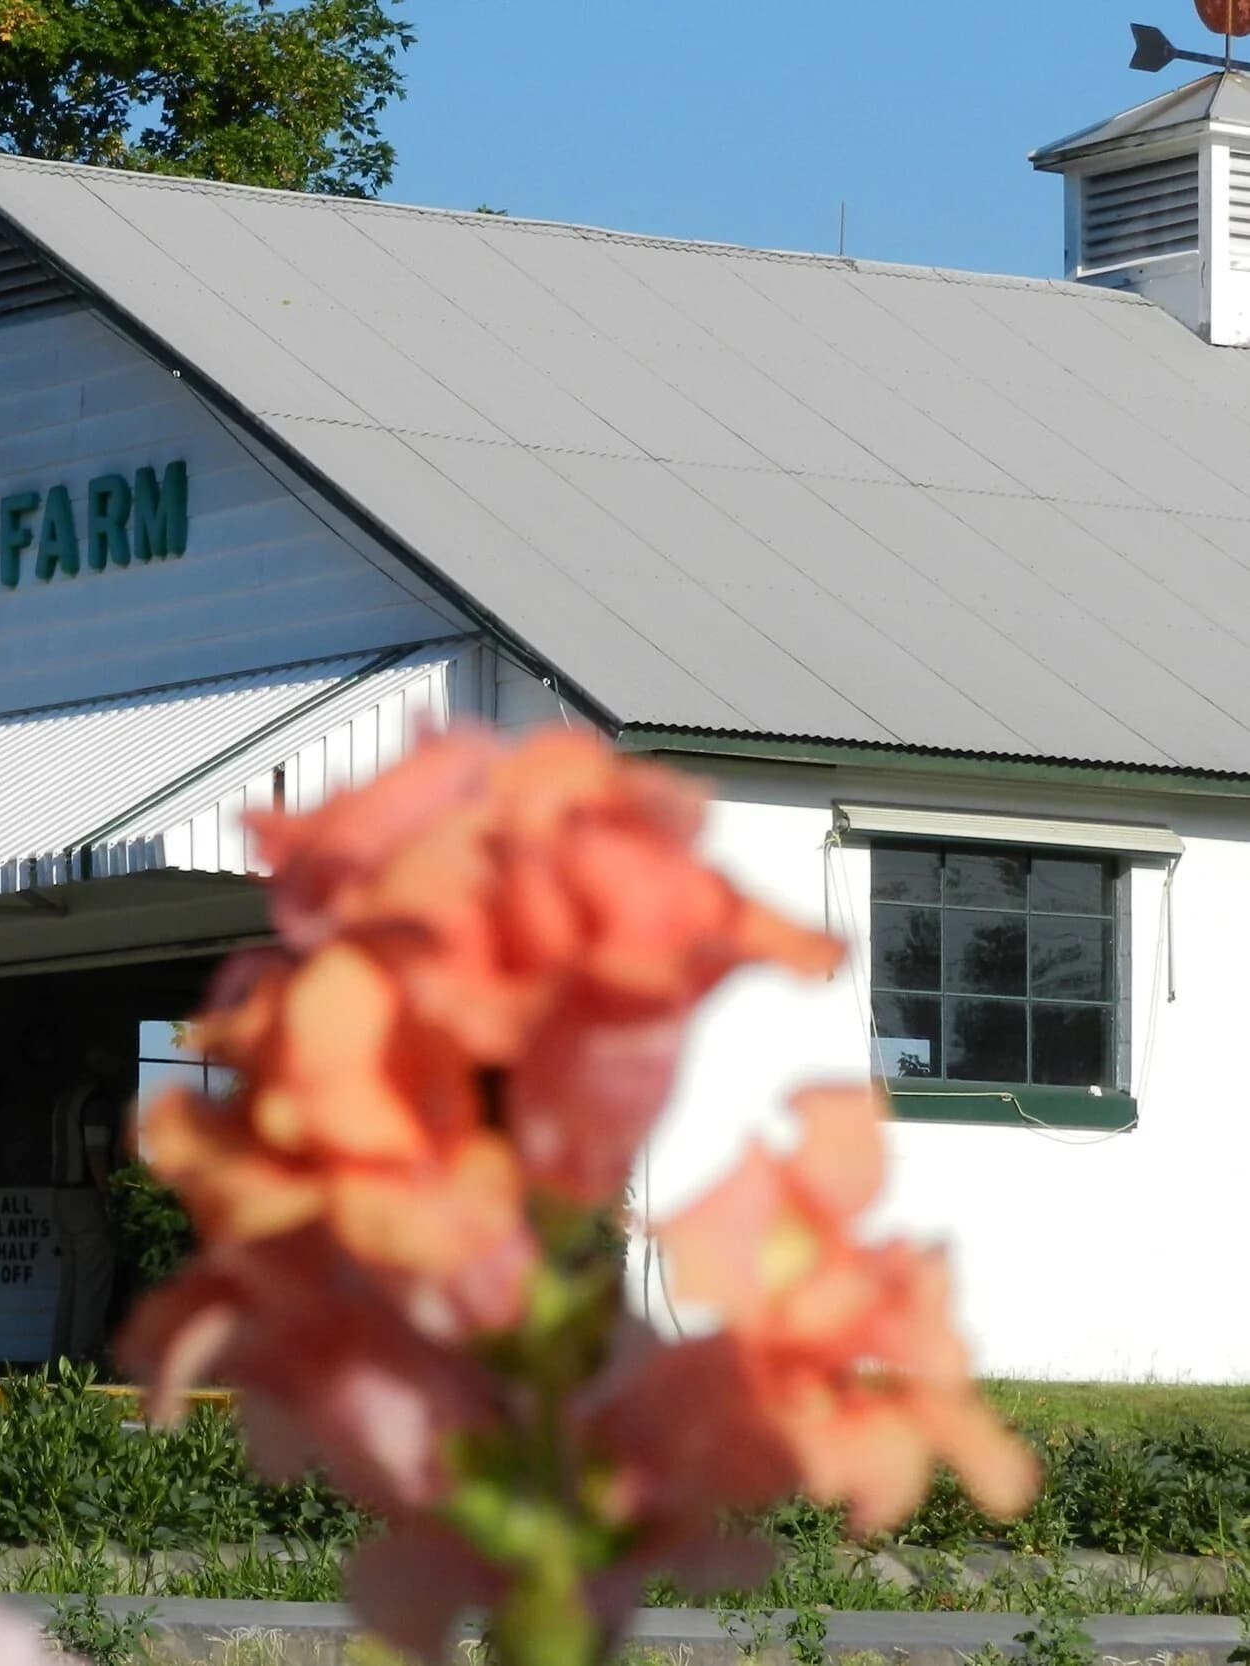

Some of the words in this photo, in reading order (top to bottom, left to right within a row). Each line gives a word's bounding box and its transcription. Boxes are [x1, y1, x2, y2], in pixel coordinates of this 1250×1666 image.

[0, 460, 189, 589] FARM
[1, 1195, 33, 1214] ALL
[1, 1265, 34, 1284] OFF
